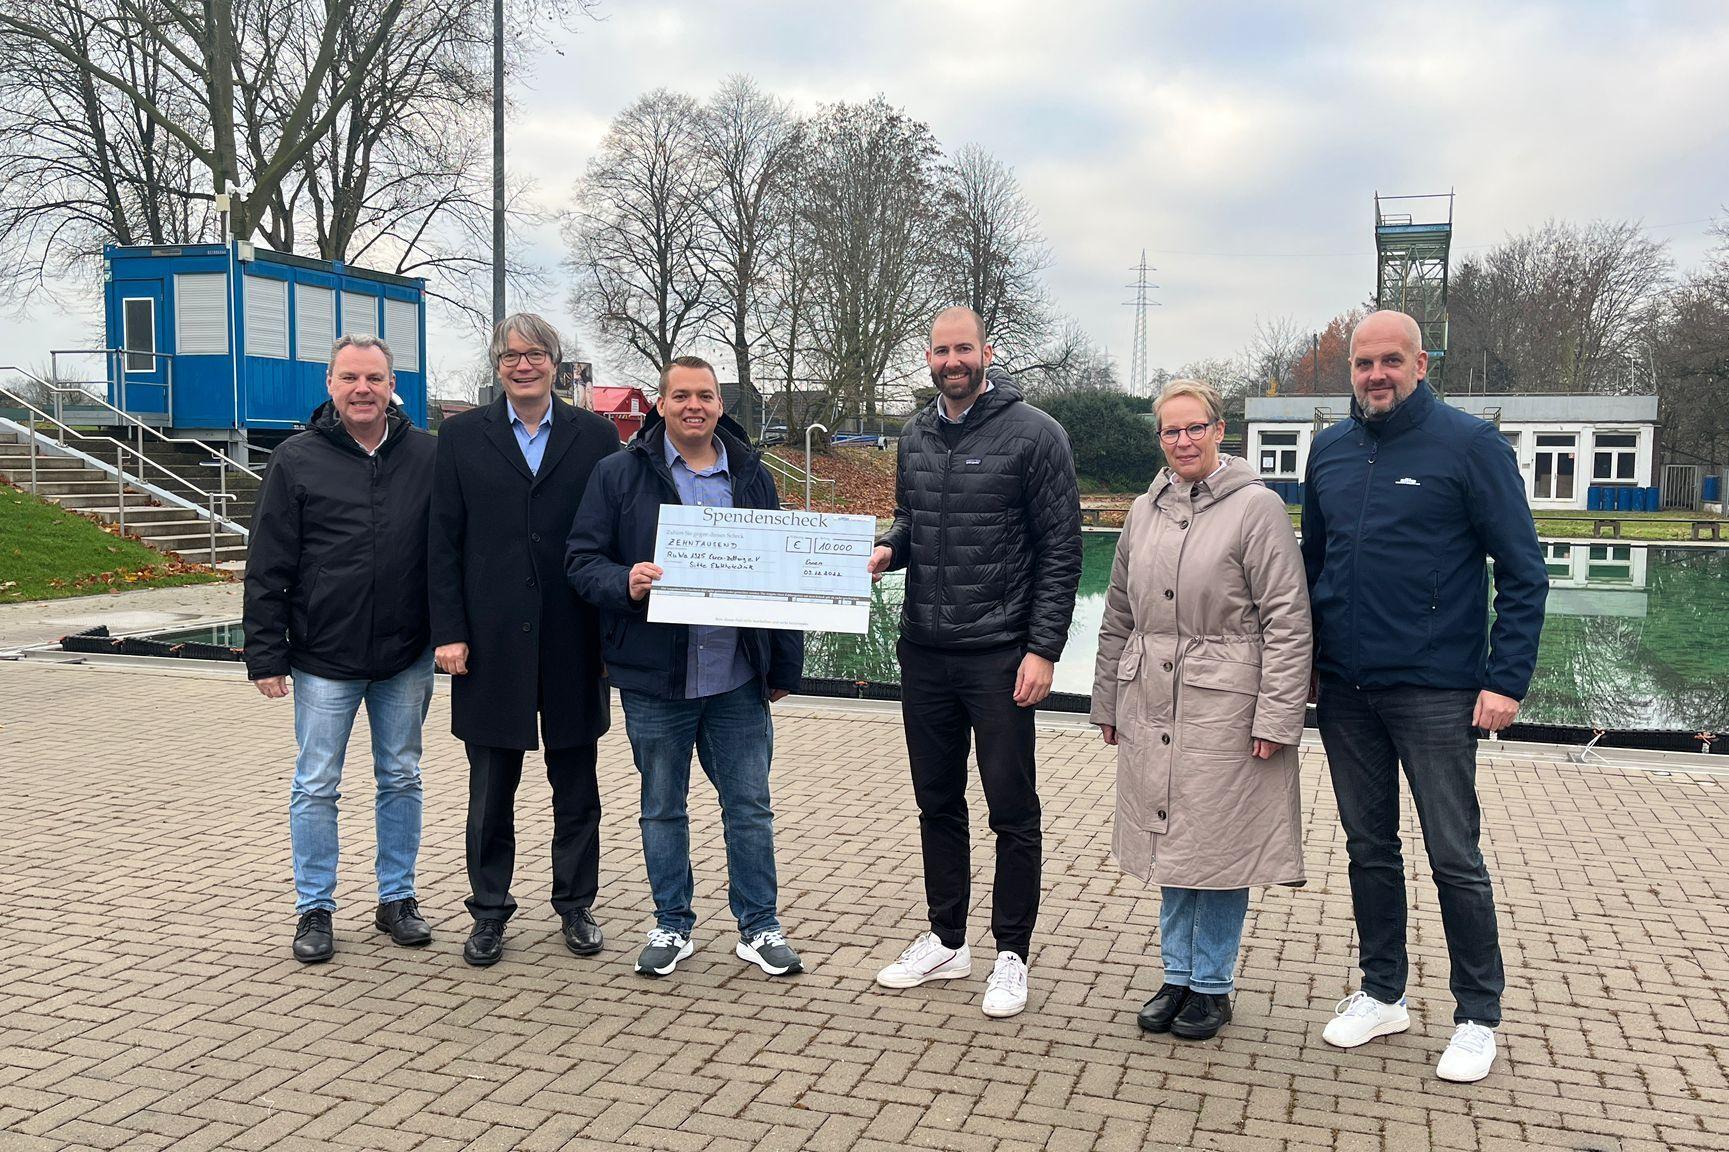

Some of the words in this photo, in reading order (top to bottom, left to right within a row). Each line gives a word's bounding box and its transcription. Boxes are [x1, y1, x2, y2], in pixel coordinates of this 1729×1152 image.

[702, 507, 828, 528] Spendenscheck
[668, 538, 738, 549] ZEHNTAUSEND
[818, 542, 853, 551] 10.000
